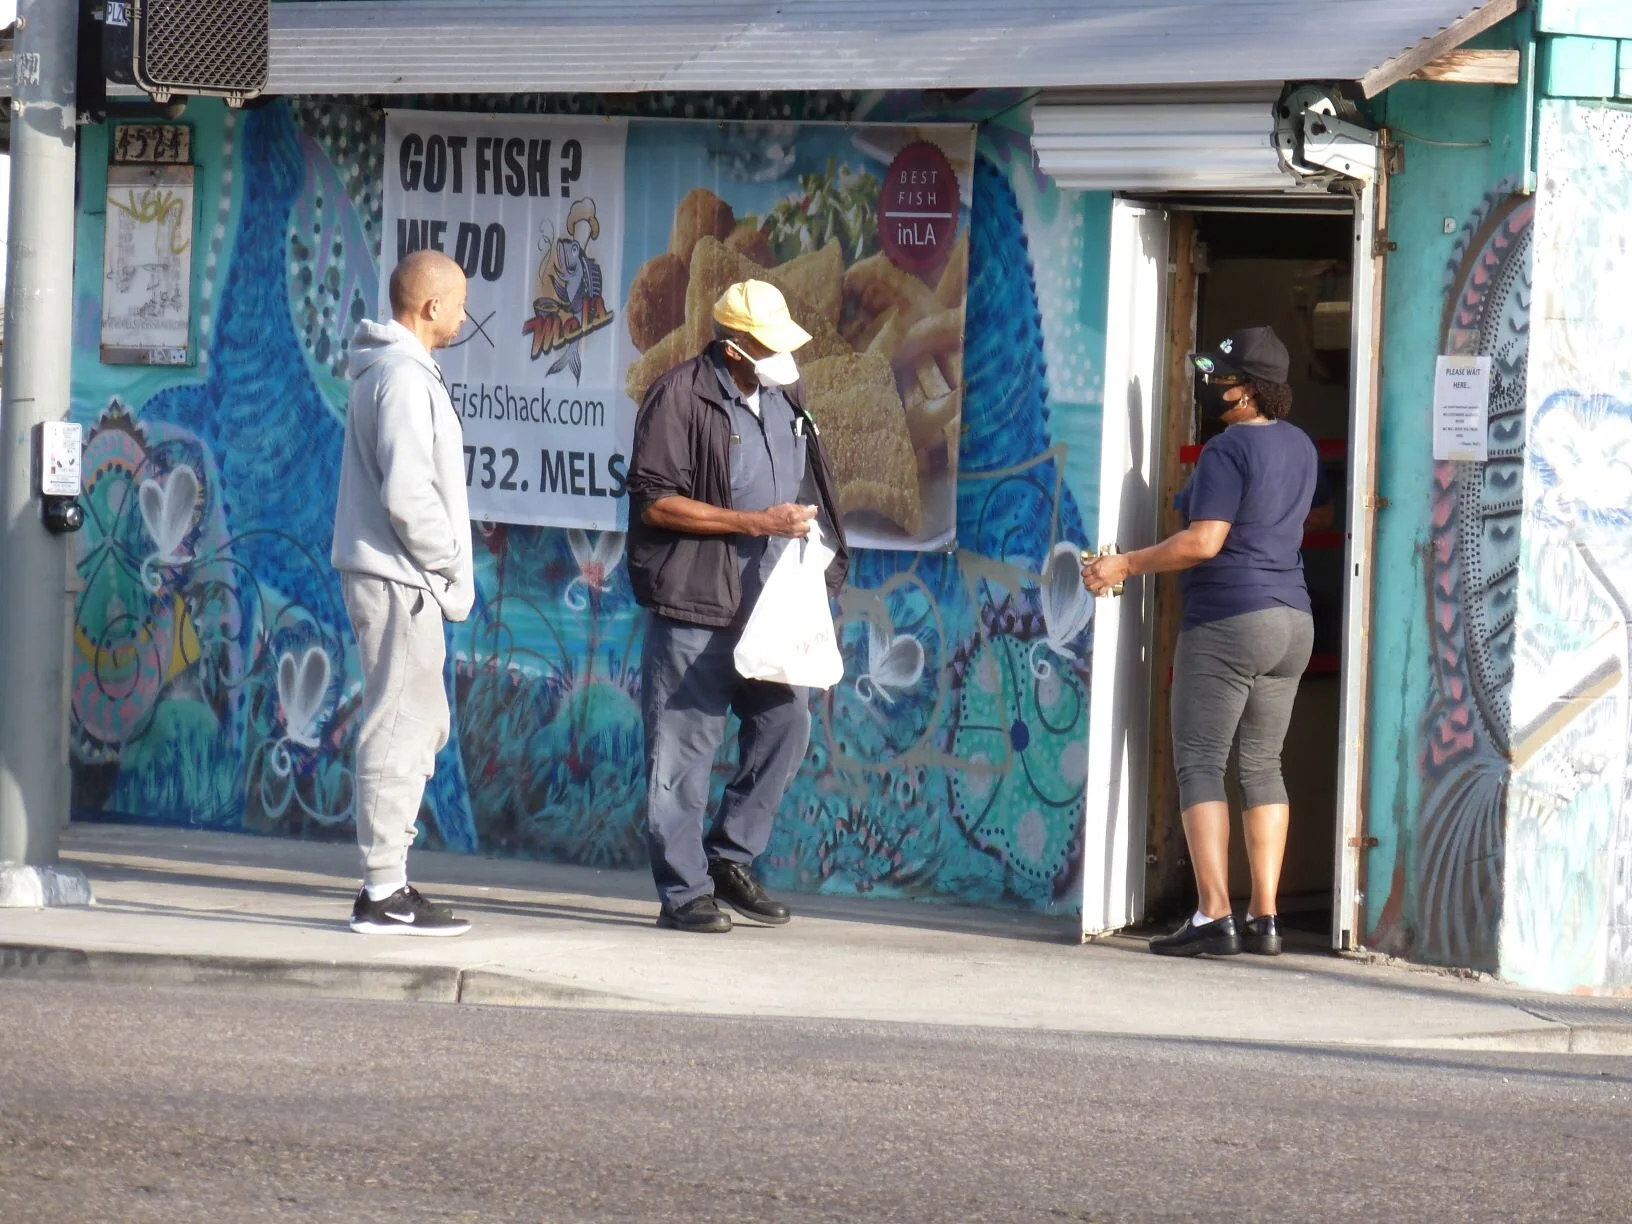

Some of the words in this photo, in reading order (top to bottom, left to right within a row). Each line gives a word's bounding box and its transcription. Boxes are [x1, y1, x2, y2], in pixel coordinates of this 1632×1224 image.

[400, 133, 467, 193] GOT
[900, 170, 938, 185] BEST
[898, 191, 937, 206] FISH
[898, 223, 937, 246] inLA
[455, 222, 506, 282] DO
[1445, 367, 1465, 376] PLEASE
[1466, 368, 1481, 376] WAIT
[450, 382, 605, 427] FishShack.com
[540, 448, 627, 498] MELS
